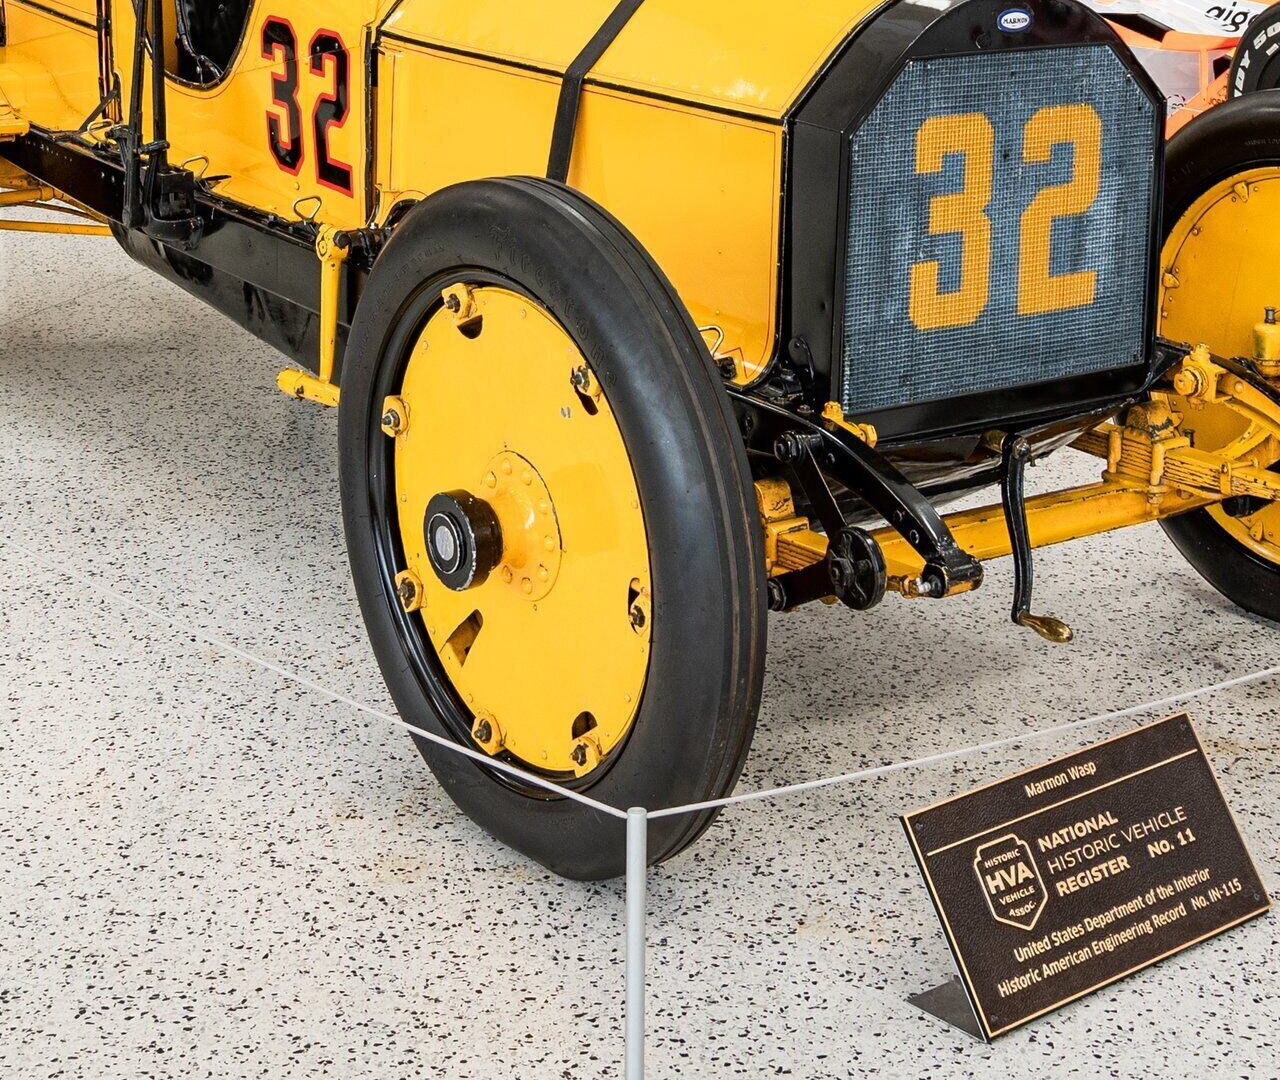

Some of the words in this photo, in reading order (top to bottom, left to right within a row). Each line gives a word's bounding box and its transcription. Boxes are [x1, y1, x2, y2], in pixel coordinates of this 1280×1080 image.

[1002, 16, 1028, 26] MARMON
[260, 14, 354, 199] 32
[908, 103, 1103, 332] 32
[1024, 770, 1069, 799] Marmon
[1068, 760, 1098, 783] Wasp
[1037, 810, 1119, 853] NATIONAL
[1047, 834, 1122, 875] HISTORIC
[1121, 806, 1188, 845] VEHICLE
[984, 848, 1022, 868] HISTORIC
[984, 860, 1036, 896] HVA
[1056, 854, 1132, 897] REGISTER
[1146, 838, 1176, 860] No.
[1176, 827, 1197, 847] 11
[998, 884, 1036, 906] VEHICLE
[1008, 900, 1037, 918] ASSOC.
[1013, 934, 1051, 964] United
[1050, 924, 1085, 948] States
[1084, 902, 1146, 936] Department
[1145, 890, 1158, 910] of
[1156, 884, 1176, 903] the
[1176, 867, 1212, 895] Interior
[997, 968, 1042, 998] Historic
[1042, 947, 1094, 978] American
[1092, 922, 1154, 958] Engineering
[1153, 902, 1187, 928] Record
[1191, 892, 1210, 912] No.
[1209, 878, 1243, 904] IN-115
